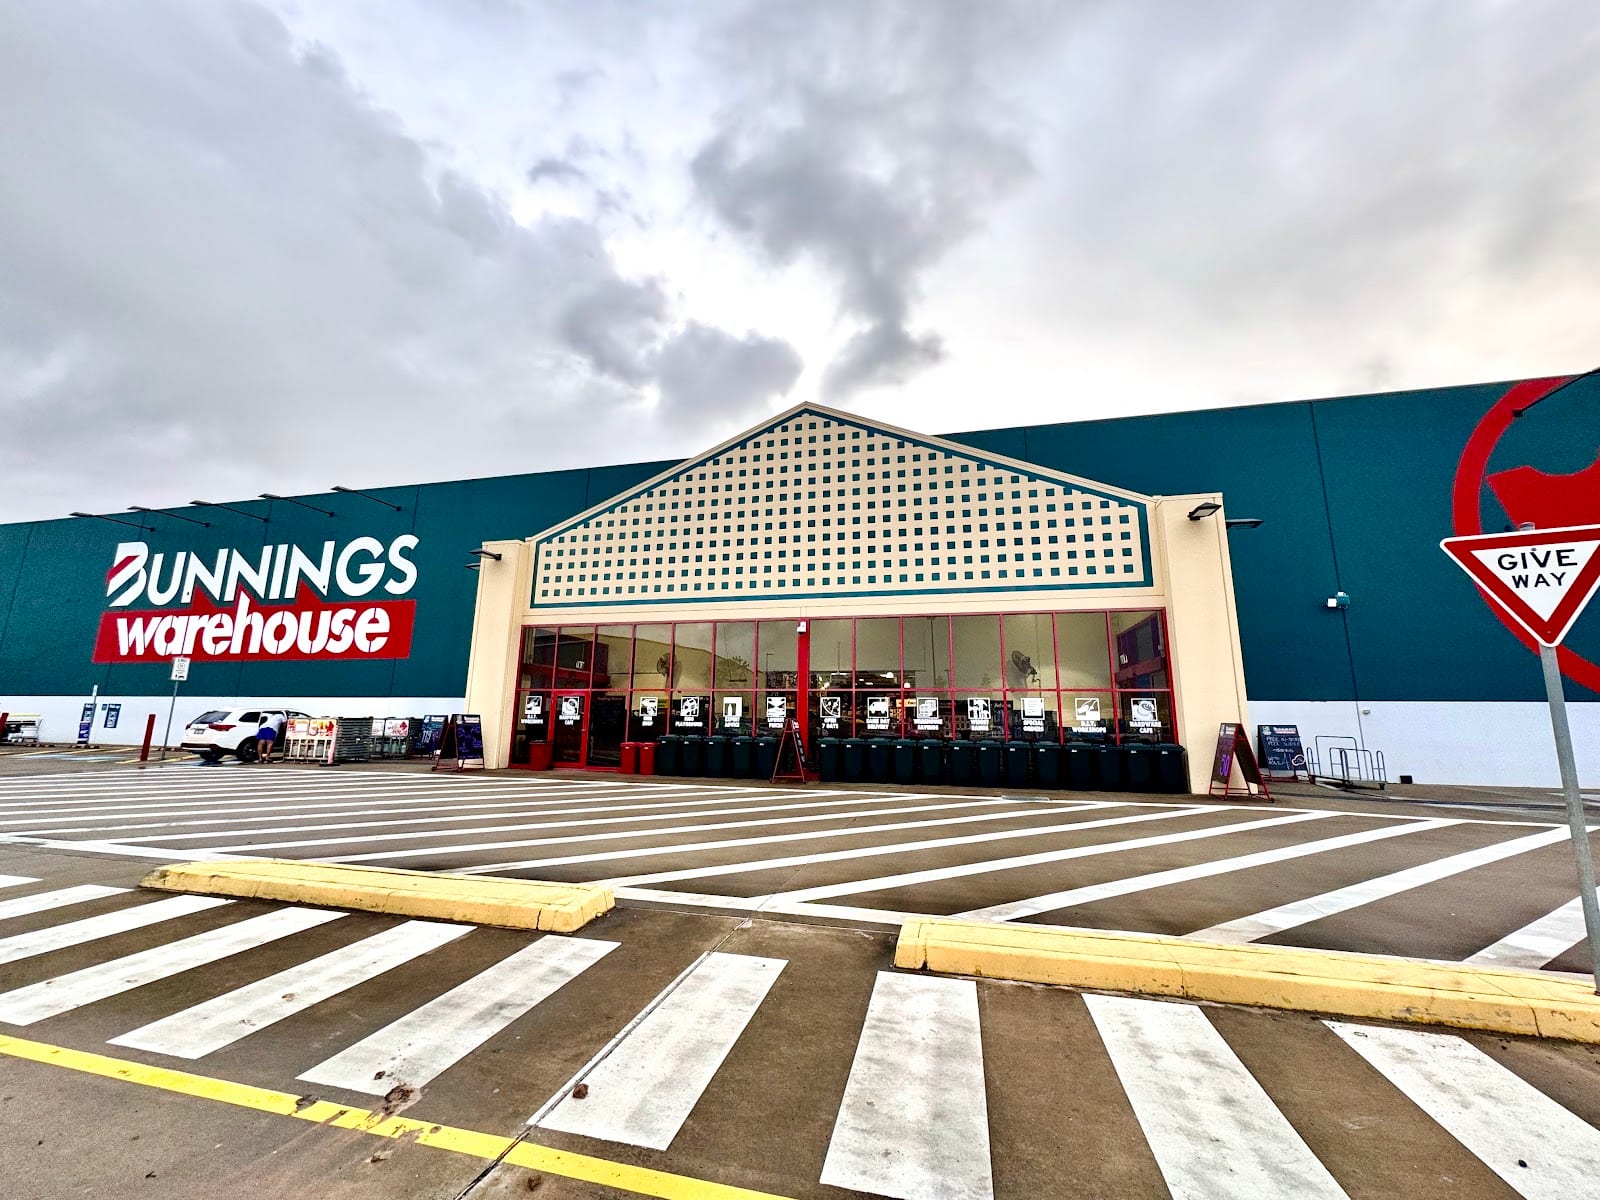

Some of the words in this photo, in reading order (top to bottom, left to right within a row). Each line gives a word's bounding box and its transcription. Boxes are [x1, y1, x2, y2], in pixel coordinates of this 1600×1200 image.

[106, 534, 419, 607] BUNNINGS
[1498, 549, 1577, 570] GIVE
[1512, 572, 1566, 588] WAY
[117, 591, 390, 656] warehouse
